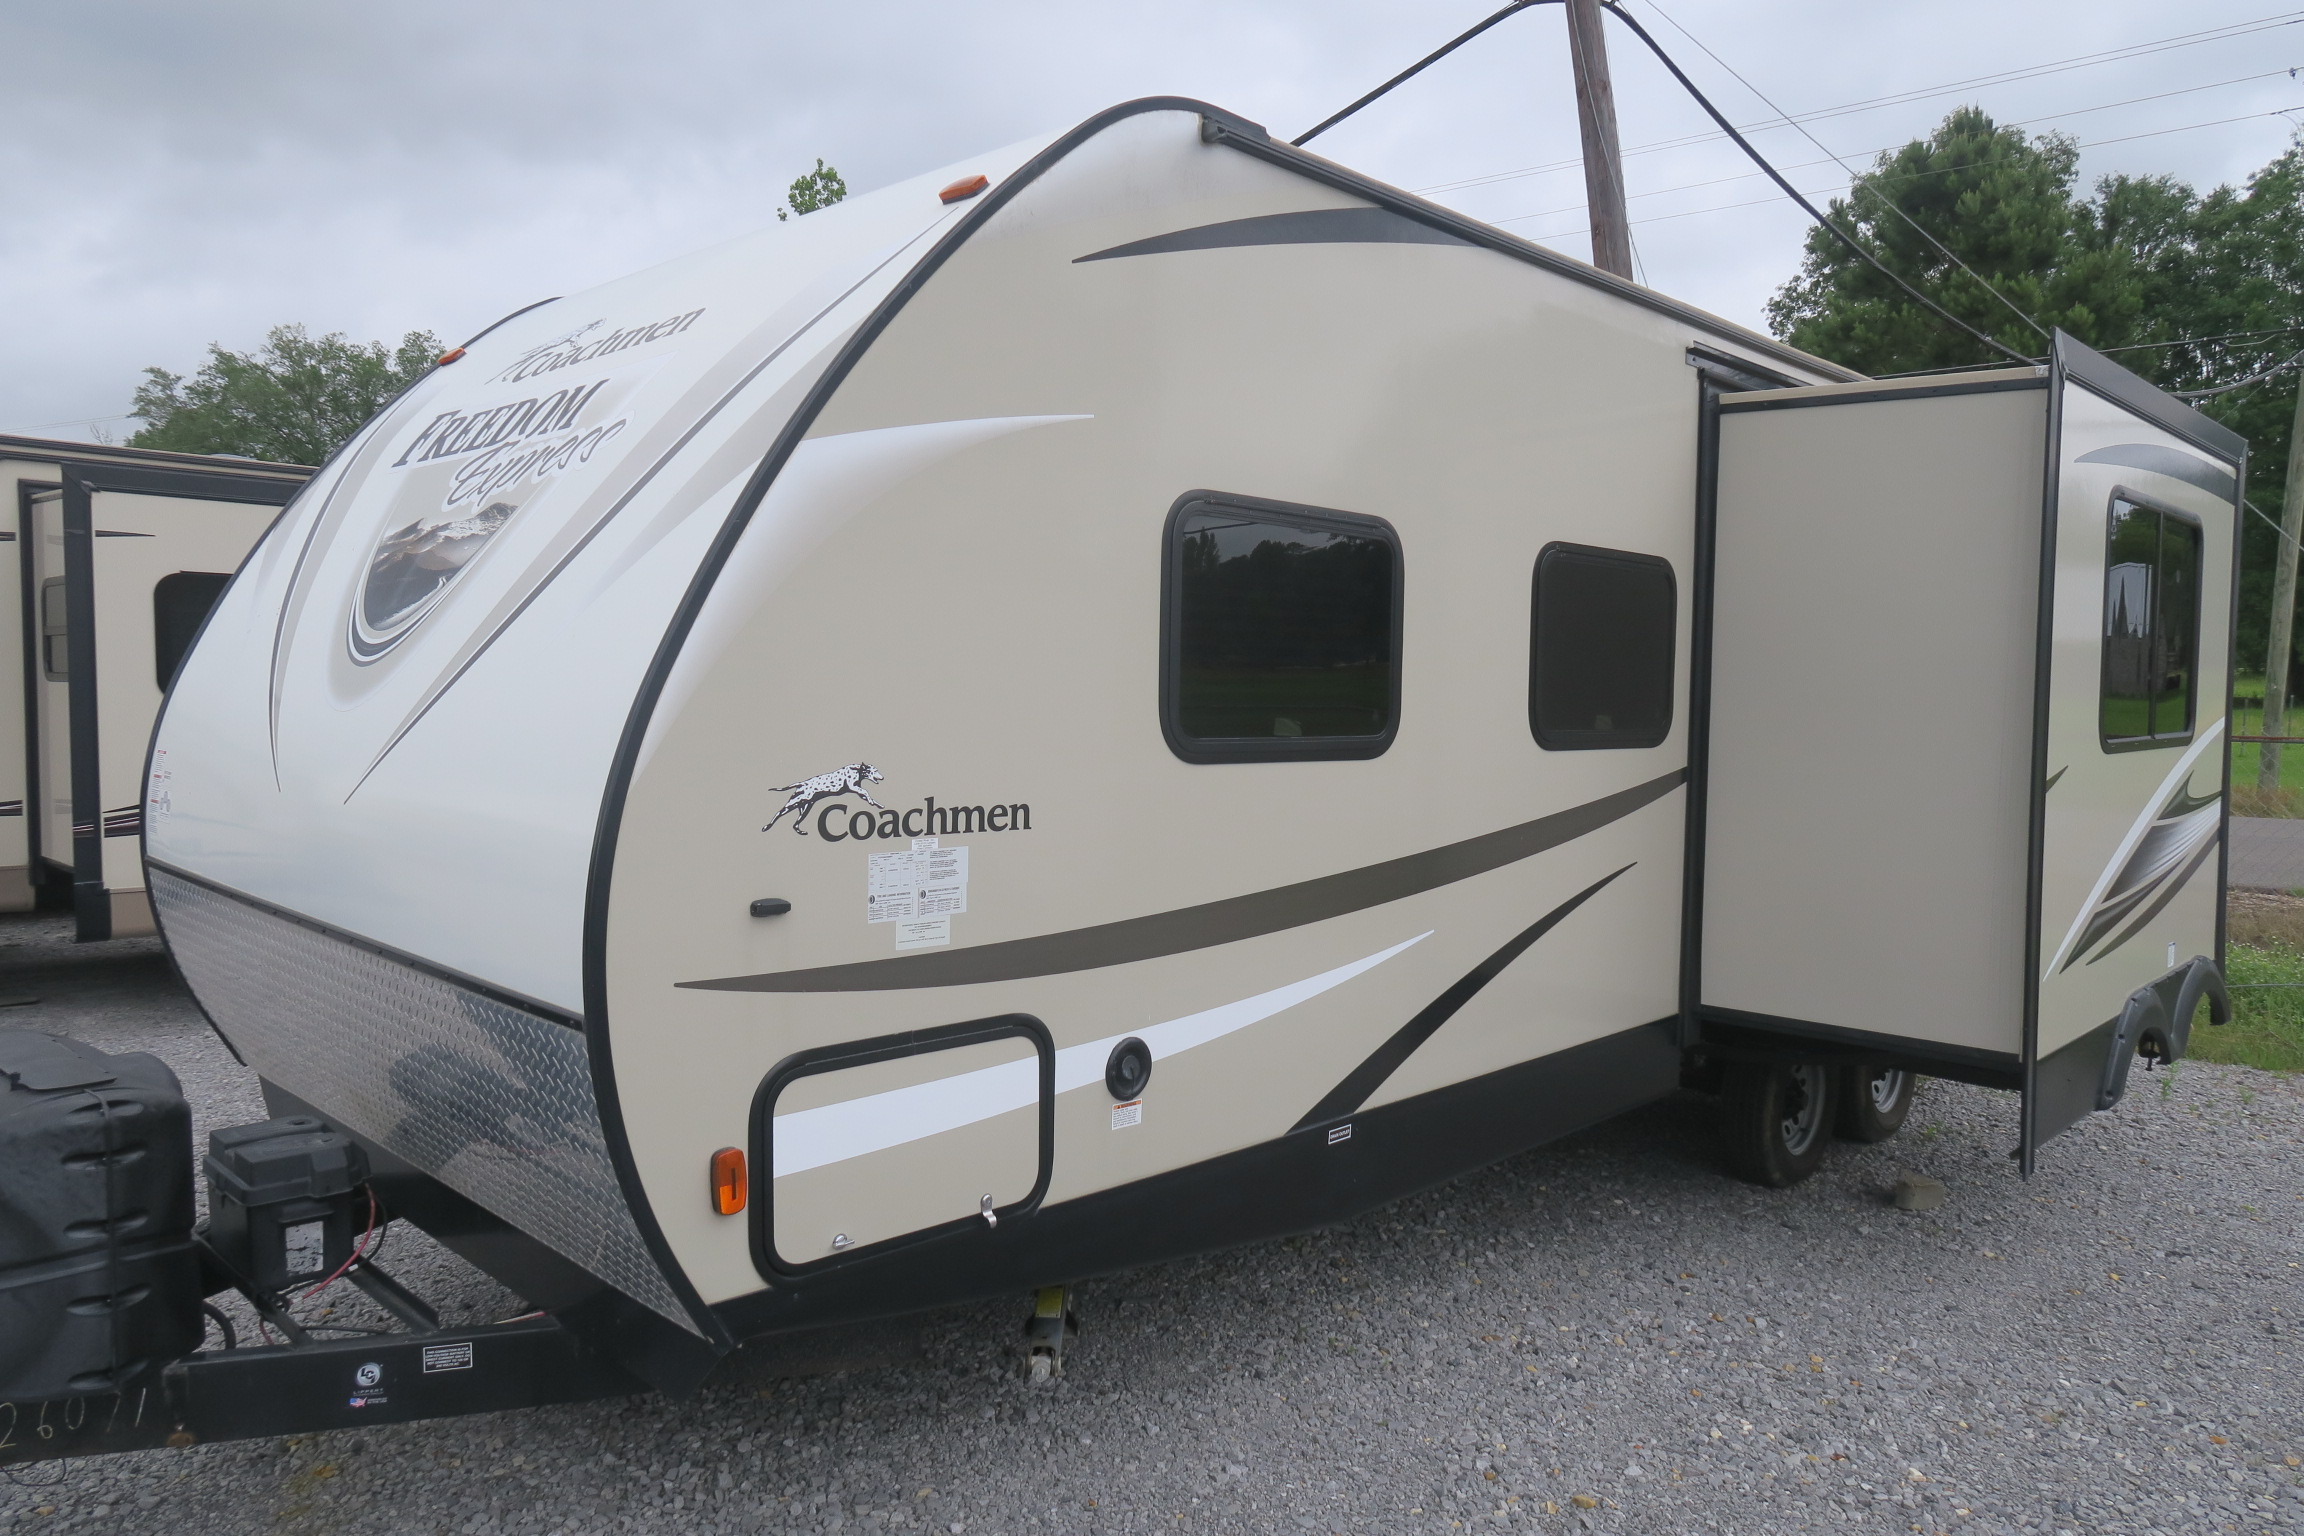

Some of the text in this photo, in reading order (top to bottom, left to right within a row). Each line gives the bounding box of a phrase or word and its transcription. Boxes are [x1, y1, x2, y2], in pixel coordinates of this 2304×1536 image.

[511, 307, 706, 384] Coachmen
[391, 378, 610, 468] FREEDOM
[446, 418, 627, 507] Express
[817, 796, 1032, 842] Coachmen
